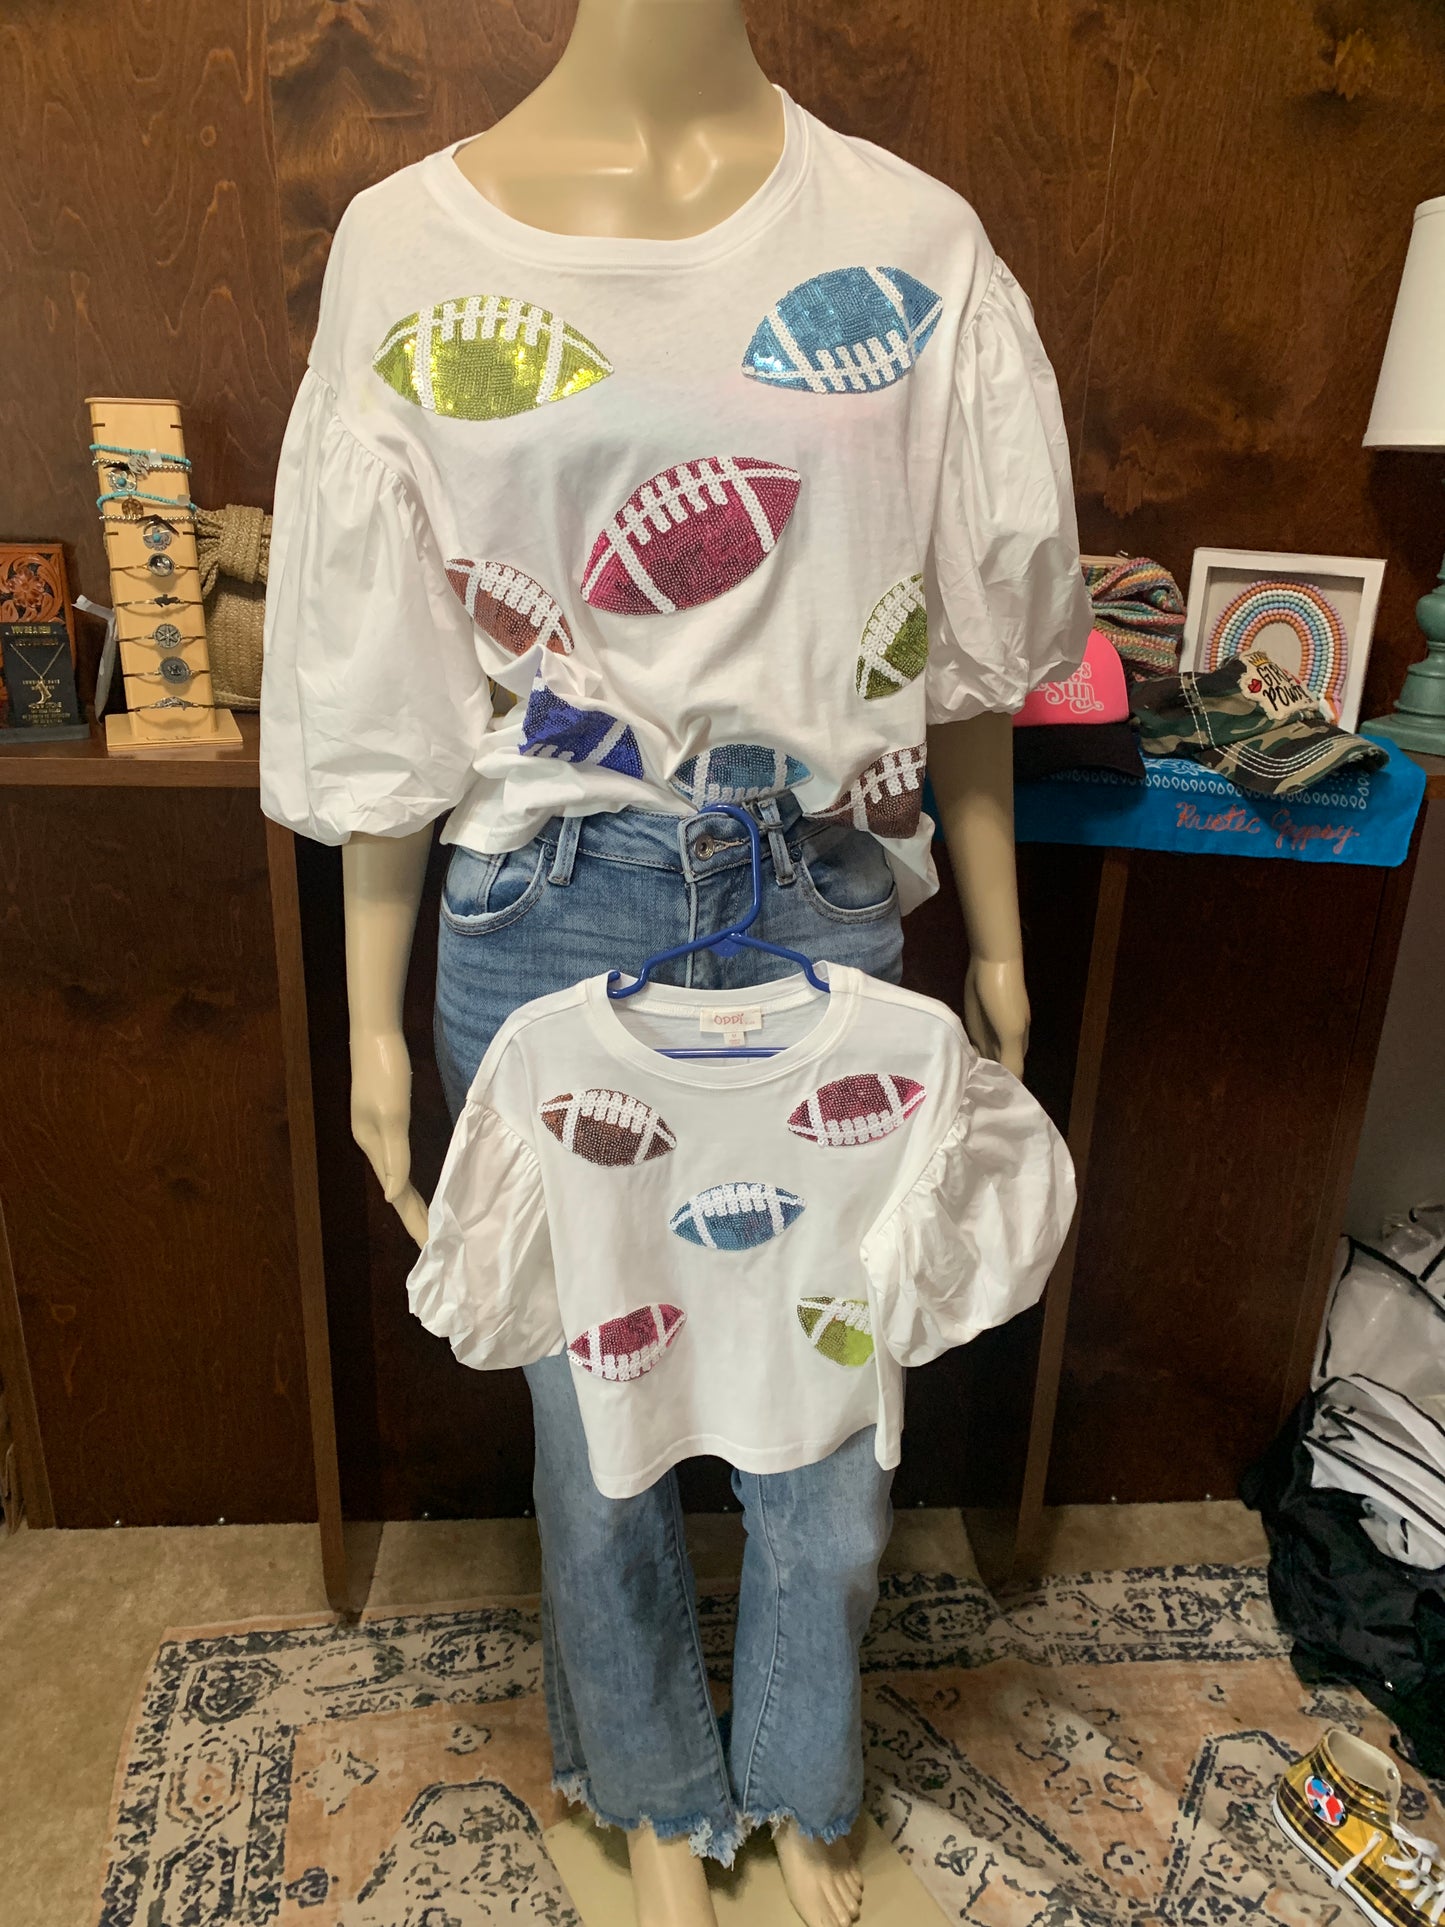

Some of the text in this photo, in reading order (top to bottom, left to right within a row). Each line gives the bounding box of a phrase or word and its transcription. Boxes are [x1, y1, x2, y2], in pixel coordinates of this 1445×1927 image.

[1257, 664, 1292, 686] GIRL
[1045, 681, 1104, 714] Sun
[1176, 802, 1359, 854] Rustic Gypsy
